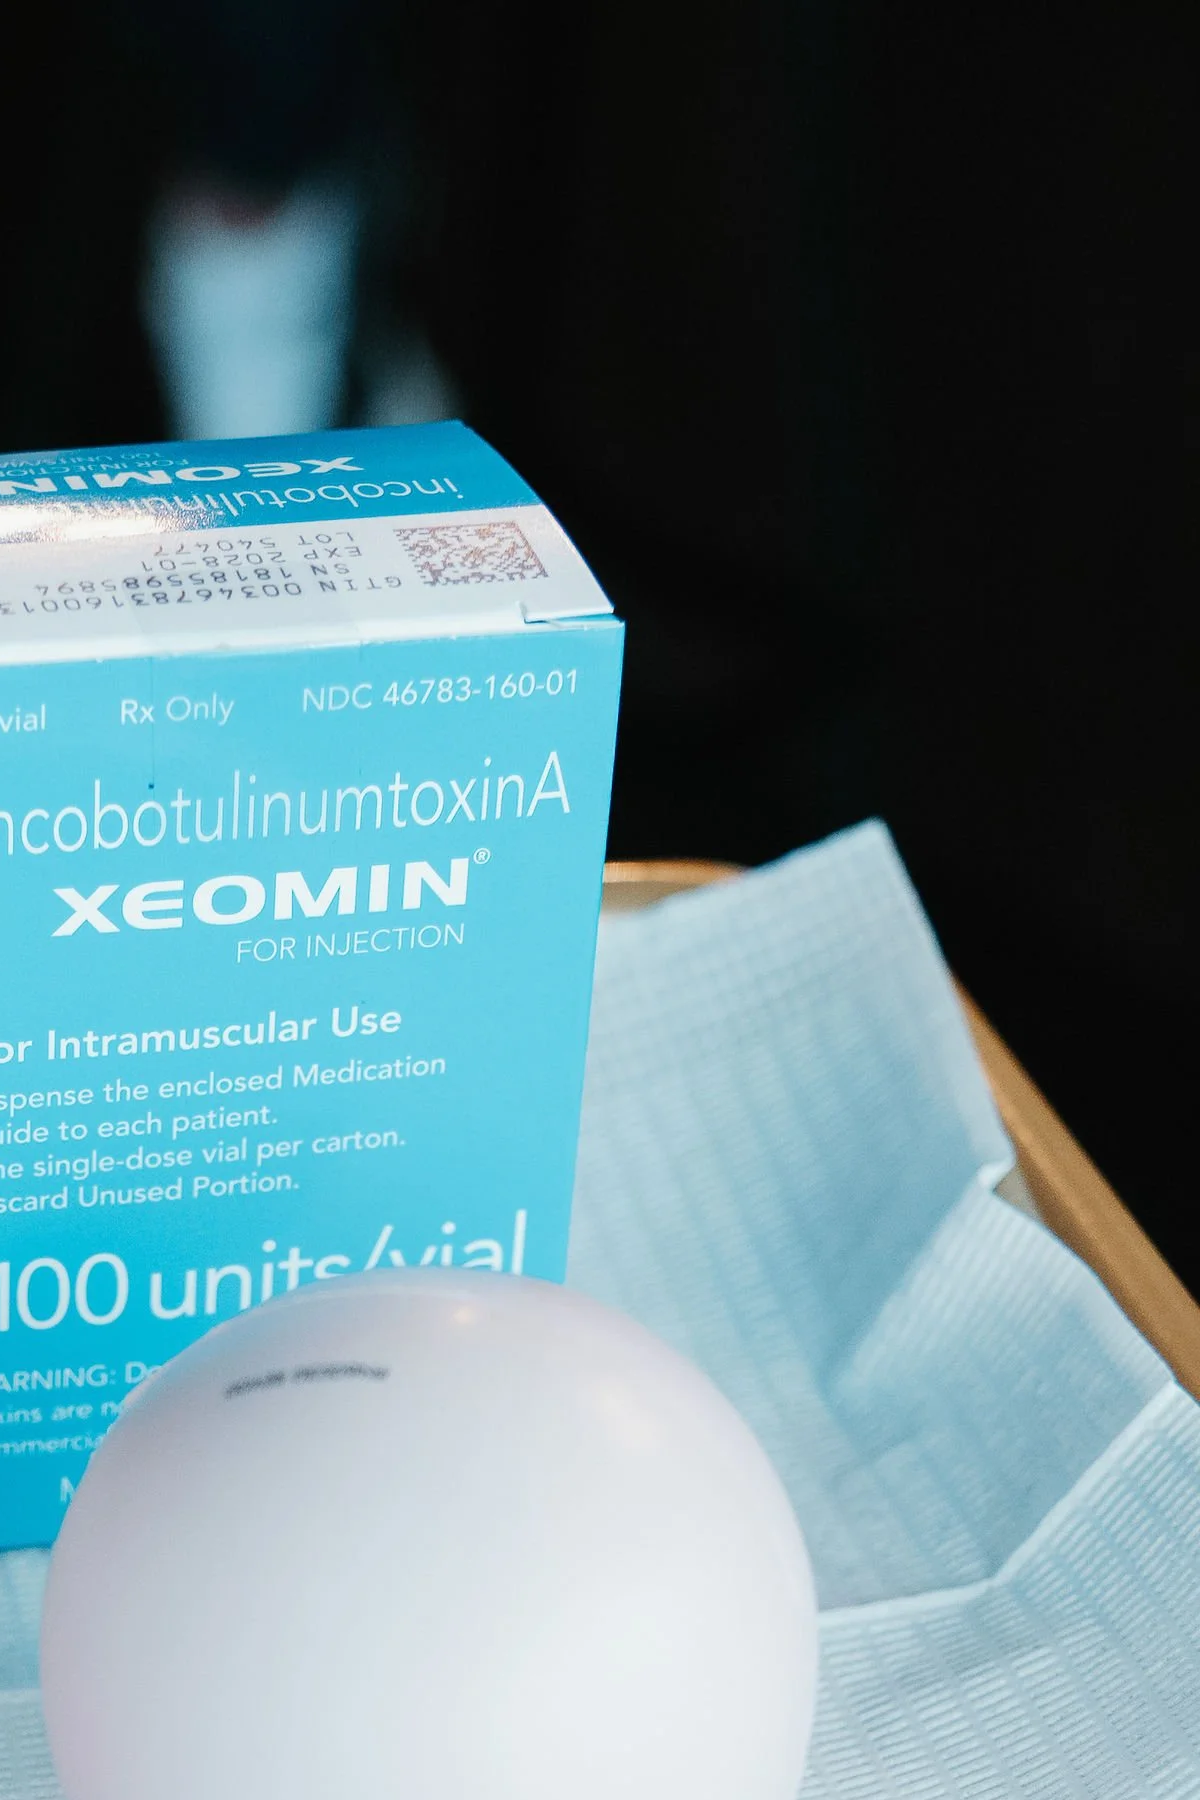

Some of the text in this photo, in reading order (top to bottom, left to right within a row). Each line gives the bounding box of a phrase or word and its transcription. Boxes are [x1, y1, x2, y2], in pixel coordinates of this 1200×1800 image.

[136, 458, 189, 470] FOR
[141, 547, 362, 571] EXP 2028-01
[153, 532, 354, 556] LOT 540477
[35, 563, 350, 595] SN 181855985894
[320, 576, 402, 593] GTIN
[302, 669, 577, 712] NDC 46783-160-01
[120, 692, 235, 727] Rx Only
[237, 923, 465, 964] FOR INJECTION
[47, 1011, 318, 1061] Intramuscular
[331, 1007, 403, 1036] Use
[103, 1077, 149, 1103] the
[158, 1066, 284, 1099] enclosed
[293, 1056, 447, 1088] Medication
[58, 1118, 88, 1142] to
[97, 1109, 162, 1139] each
[171, 1104, 279, 1140] patient.
[32, 1144, 193, 1183] single-dose
[202, 1139, 248, 1164] vial
[257, 1139, 303, 1168] per
[312, 1127, 407, 1156] carton.
[78, 1178, 183, 1209] Unused
[192, 1171, 300, 1200] Portion.
[52, 1404, 93, 1421] are
